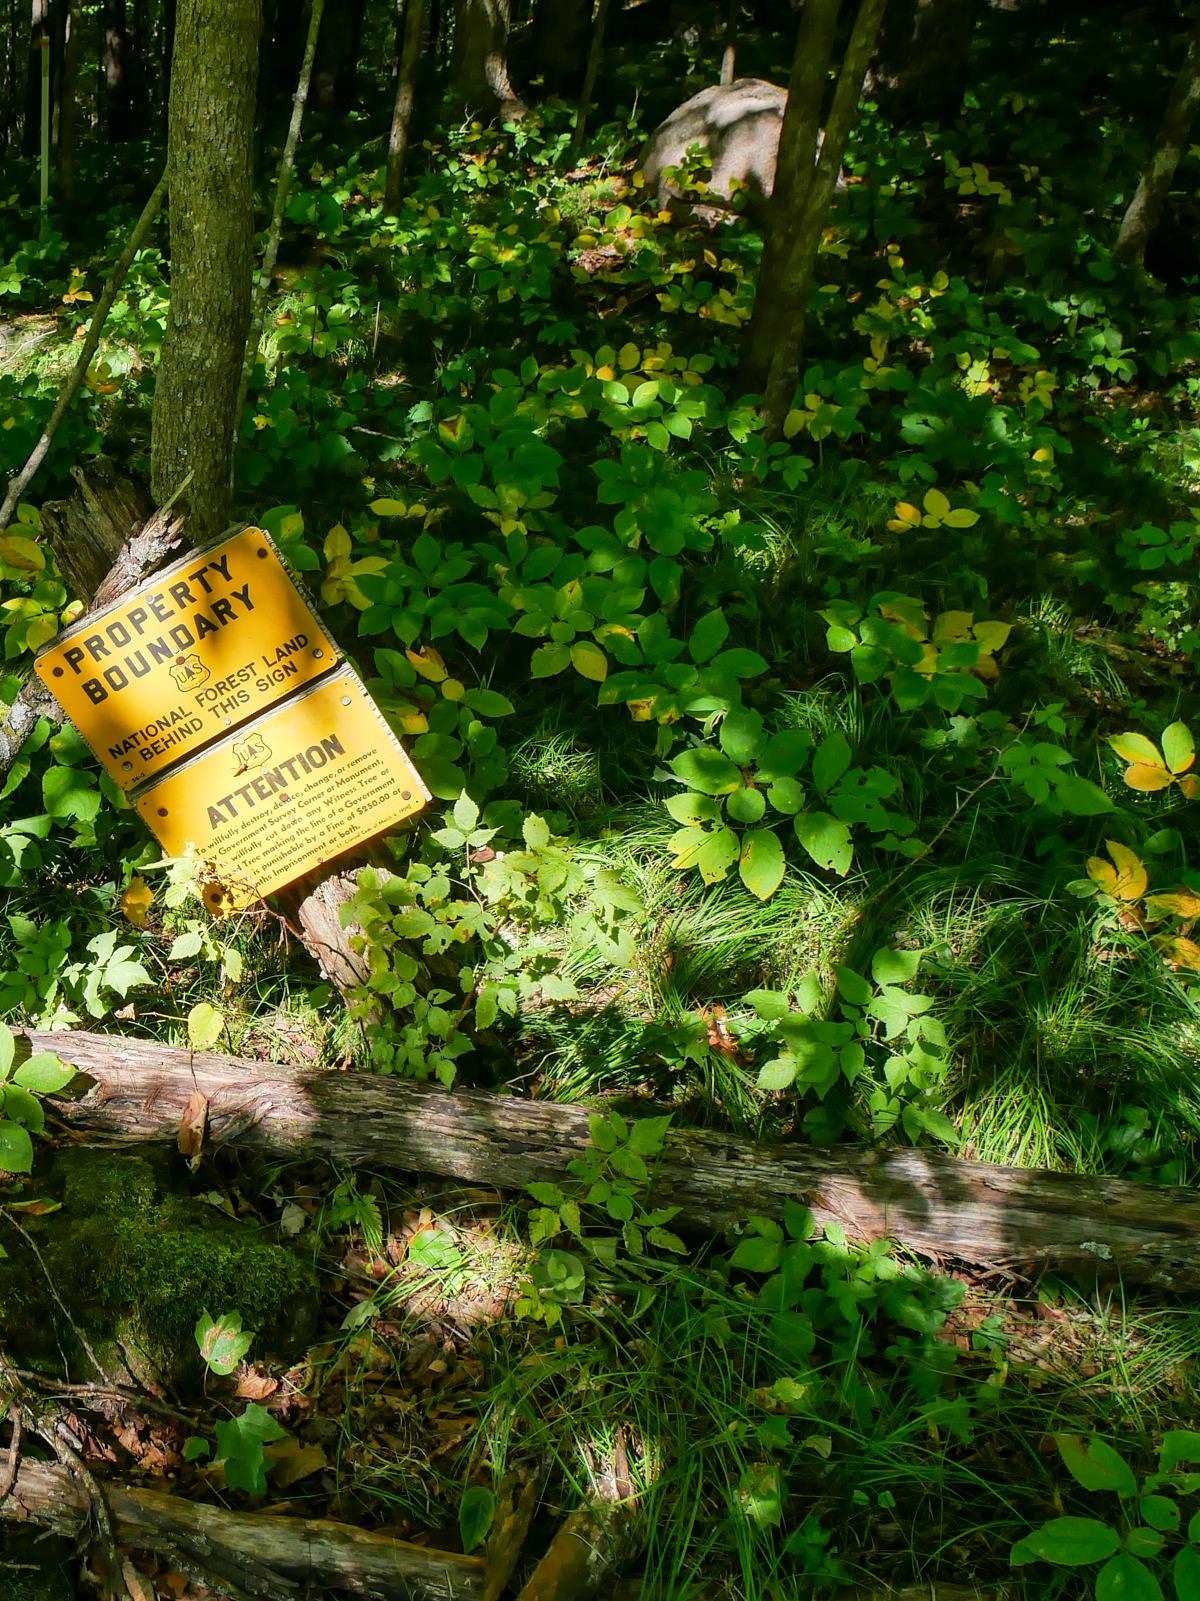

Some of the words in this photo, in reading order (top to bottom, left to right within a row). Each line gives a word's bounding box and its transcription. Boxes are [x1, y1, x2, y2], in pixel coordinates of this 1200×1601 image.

[62, 554, 233, 676] PROPERTY
[80, 582, 255, 706] BOUNDARY
[108, 705, 193, 760] NATIONAL
[194, 661, 257, 708] FOREST
[261, 634, 309, 668] LAND
[139, 717, 204, 762] BEHIND
[207, 689, 251, 719] THIS
[255, 660, 299, 692] SIGN
[193, 847, 207, 856] To
[207, 828, 239, 849] willfully
[240, 809, 273, 830] destroy,
[303, 773, 337, 793] change,
[336, 766, 346, 774] or
[346, 748, 378, 769] remove
[206, 733, 346, 831] ATTENTION
[218, 823, 268, 856] Government
[267, 807, 297, 827] Survey
[297, 791, 325, 809] Corner
[326, 785, 335, 793] or
[334, 758, 384, 788] Monument,
[230, 840, 262, 862] willfully
[265, 830, 279, 842] cut
[305, 806, 322, 818] any
[322, 786, 358, 807] Witness
[357, 775, 378, 788] Tree
[380, 768, 390, 776] or
[241, 855, 261, 868] Tree
[261, 834, 296, 857] marking
[295, 826, 310, 837] the
[309, 817, 326, 829] line
[327, 809, 337, 819] of
[344, 777, 396, 809] Government
[261, 842, 305, 872] punishable
[304, 834, 317, 844] by
[325, 819, 345, 833] Fine
[346, 811, 356, 822] of
[356, 792, 391, 816] $250.00
[392, 787, 401, 796] or
[271, 841, 327, 877] Imprisonment
[328, 836, 337, 845] or
[337, 824, 361, 839] both.
